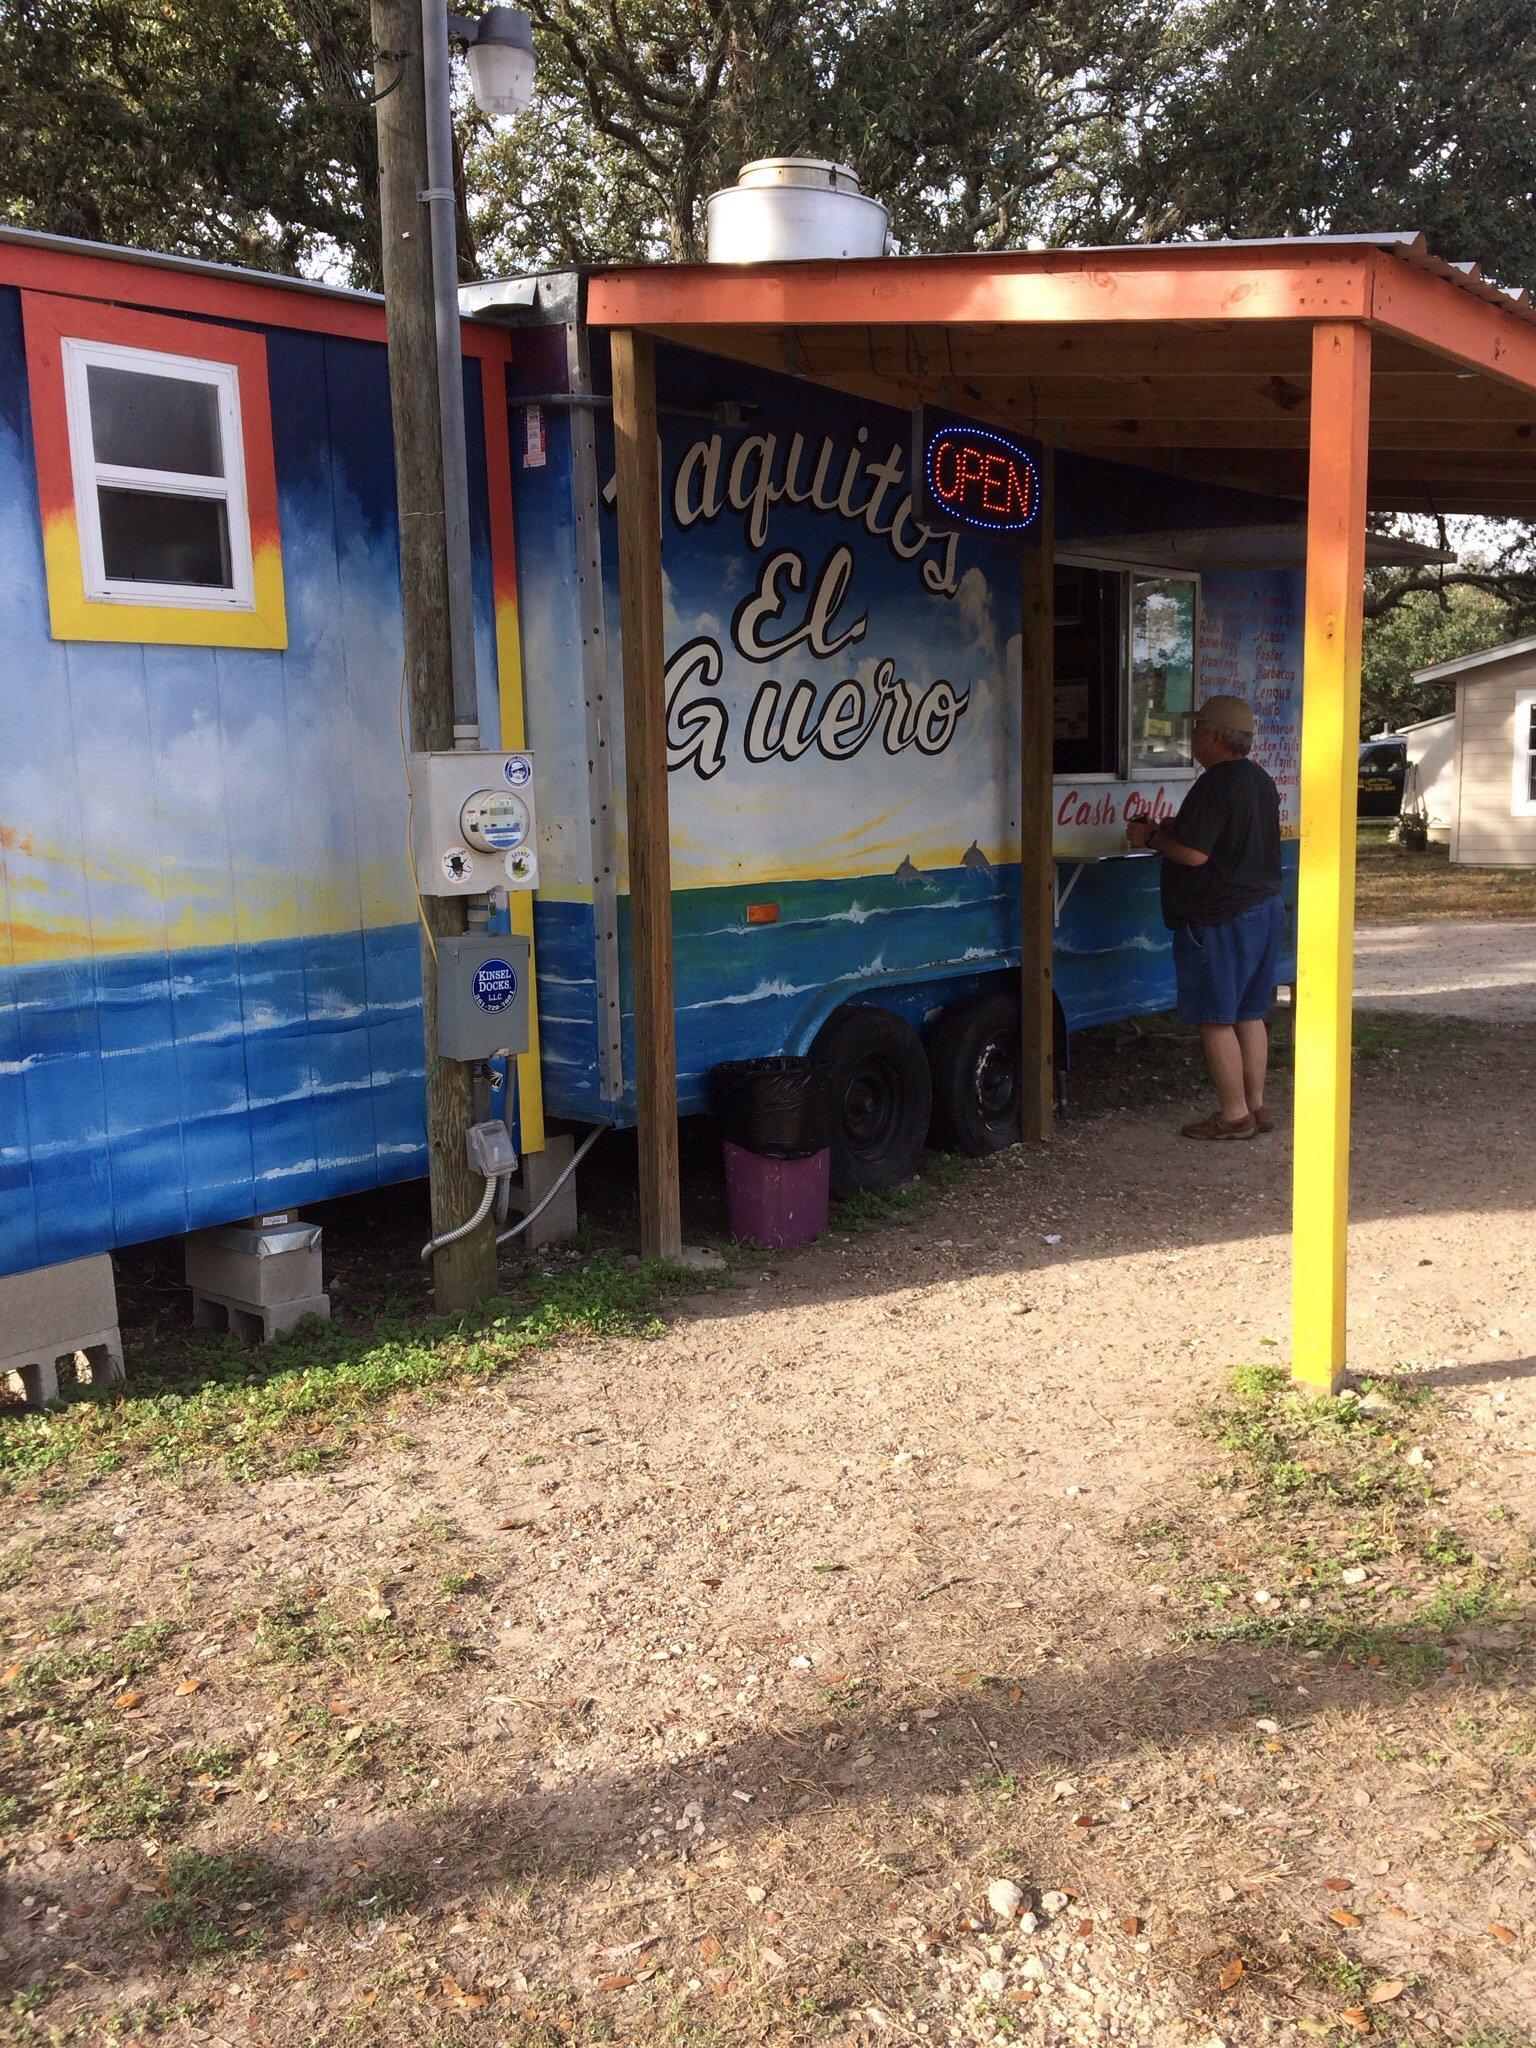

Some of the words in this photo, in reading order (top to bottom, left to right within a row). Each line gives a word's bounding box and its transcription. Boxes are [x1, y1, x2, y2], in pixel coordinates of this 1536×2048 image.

[603, 425, 961, 598] aquitos
[935, 443, 1030, 518] OPEN
[731, 542, 868, 663] El
[665, 636, 970, 779] Guero
[1253, 685, 1291, 702] Lengua
[1057, 789, 1118, 827] Cash
[478, 969, 511, 981] KINSEL
